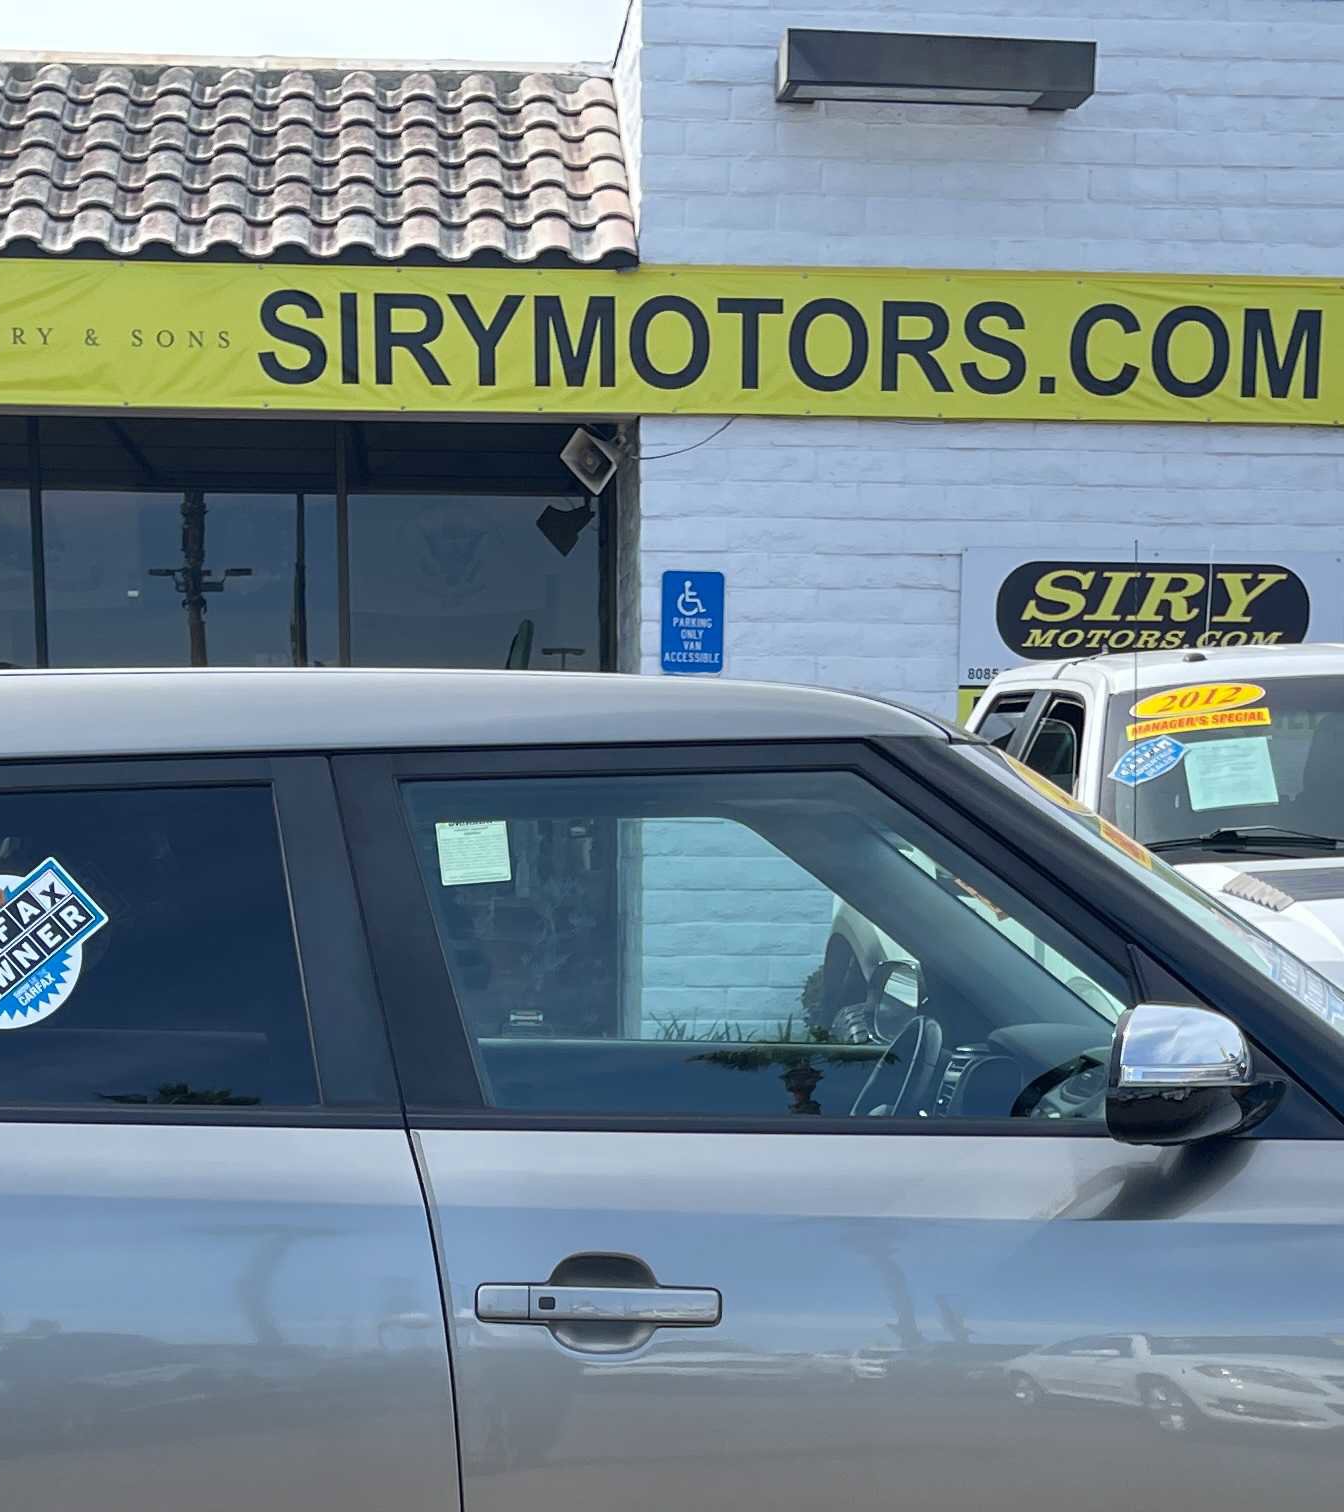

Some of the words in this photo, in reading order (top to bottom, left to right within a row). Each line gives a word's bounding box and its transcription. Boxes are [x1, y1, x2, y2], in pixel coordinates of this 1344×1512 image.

[84, 326, 101, 348] &
[130, 329, 233, 350] SONS
[257, 289, 1323, 400] SIRYMOTORS.COM
[1020, 568, 1289, 624] SIRY
[672, 617, 713, 628] PARKING
[681, 629, 704, 639] ONLY
[683, 640, 702, 650] VAN
[1021, 628, 1284, 649] MOTORS.COM
[663, 652, 721, 663] ACCESSIBLE
[1157, 686, 1242, 713] 2012
[1131, 714, 1208, 736] MANAGER'S
[1211, 711, 1266, 724] SPECIAL
[17, 971, 56, 1007] CARFAX
